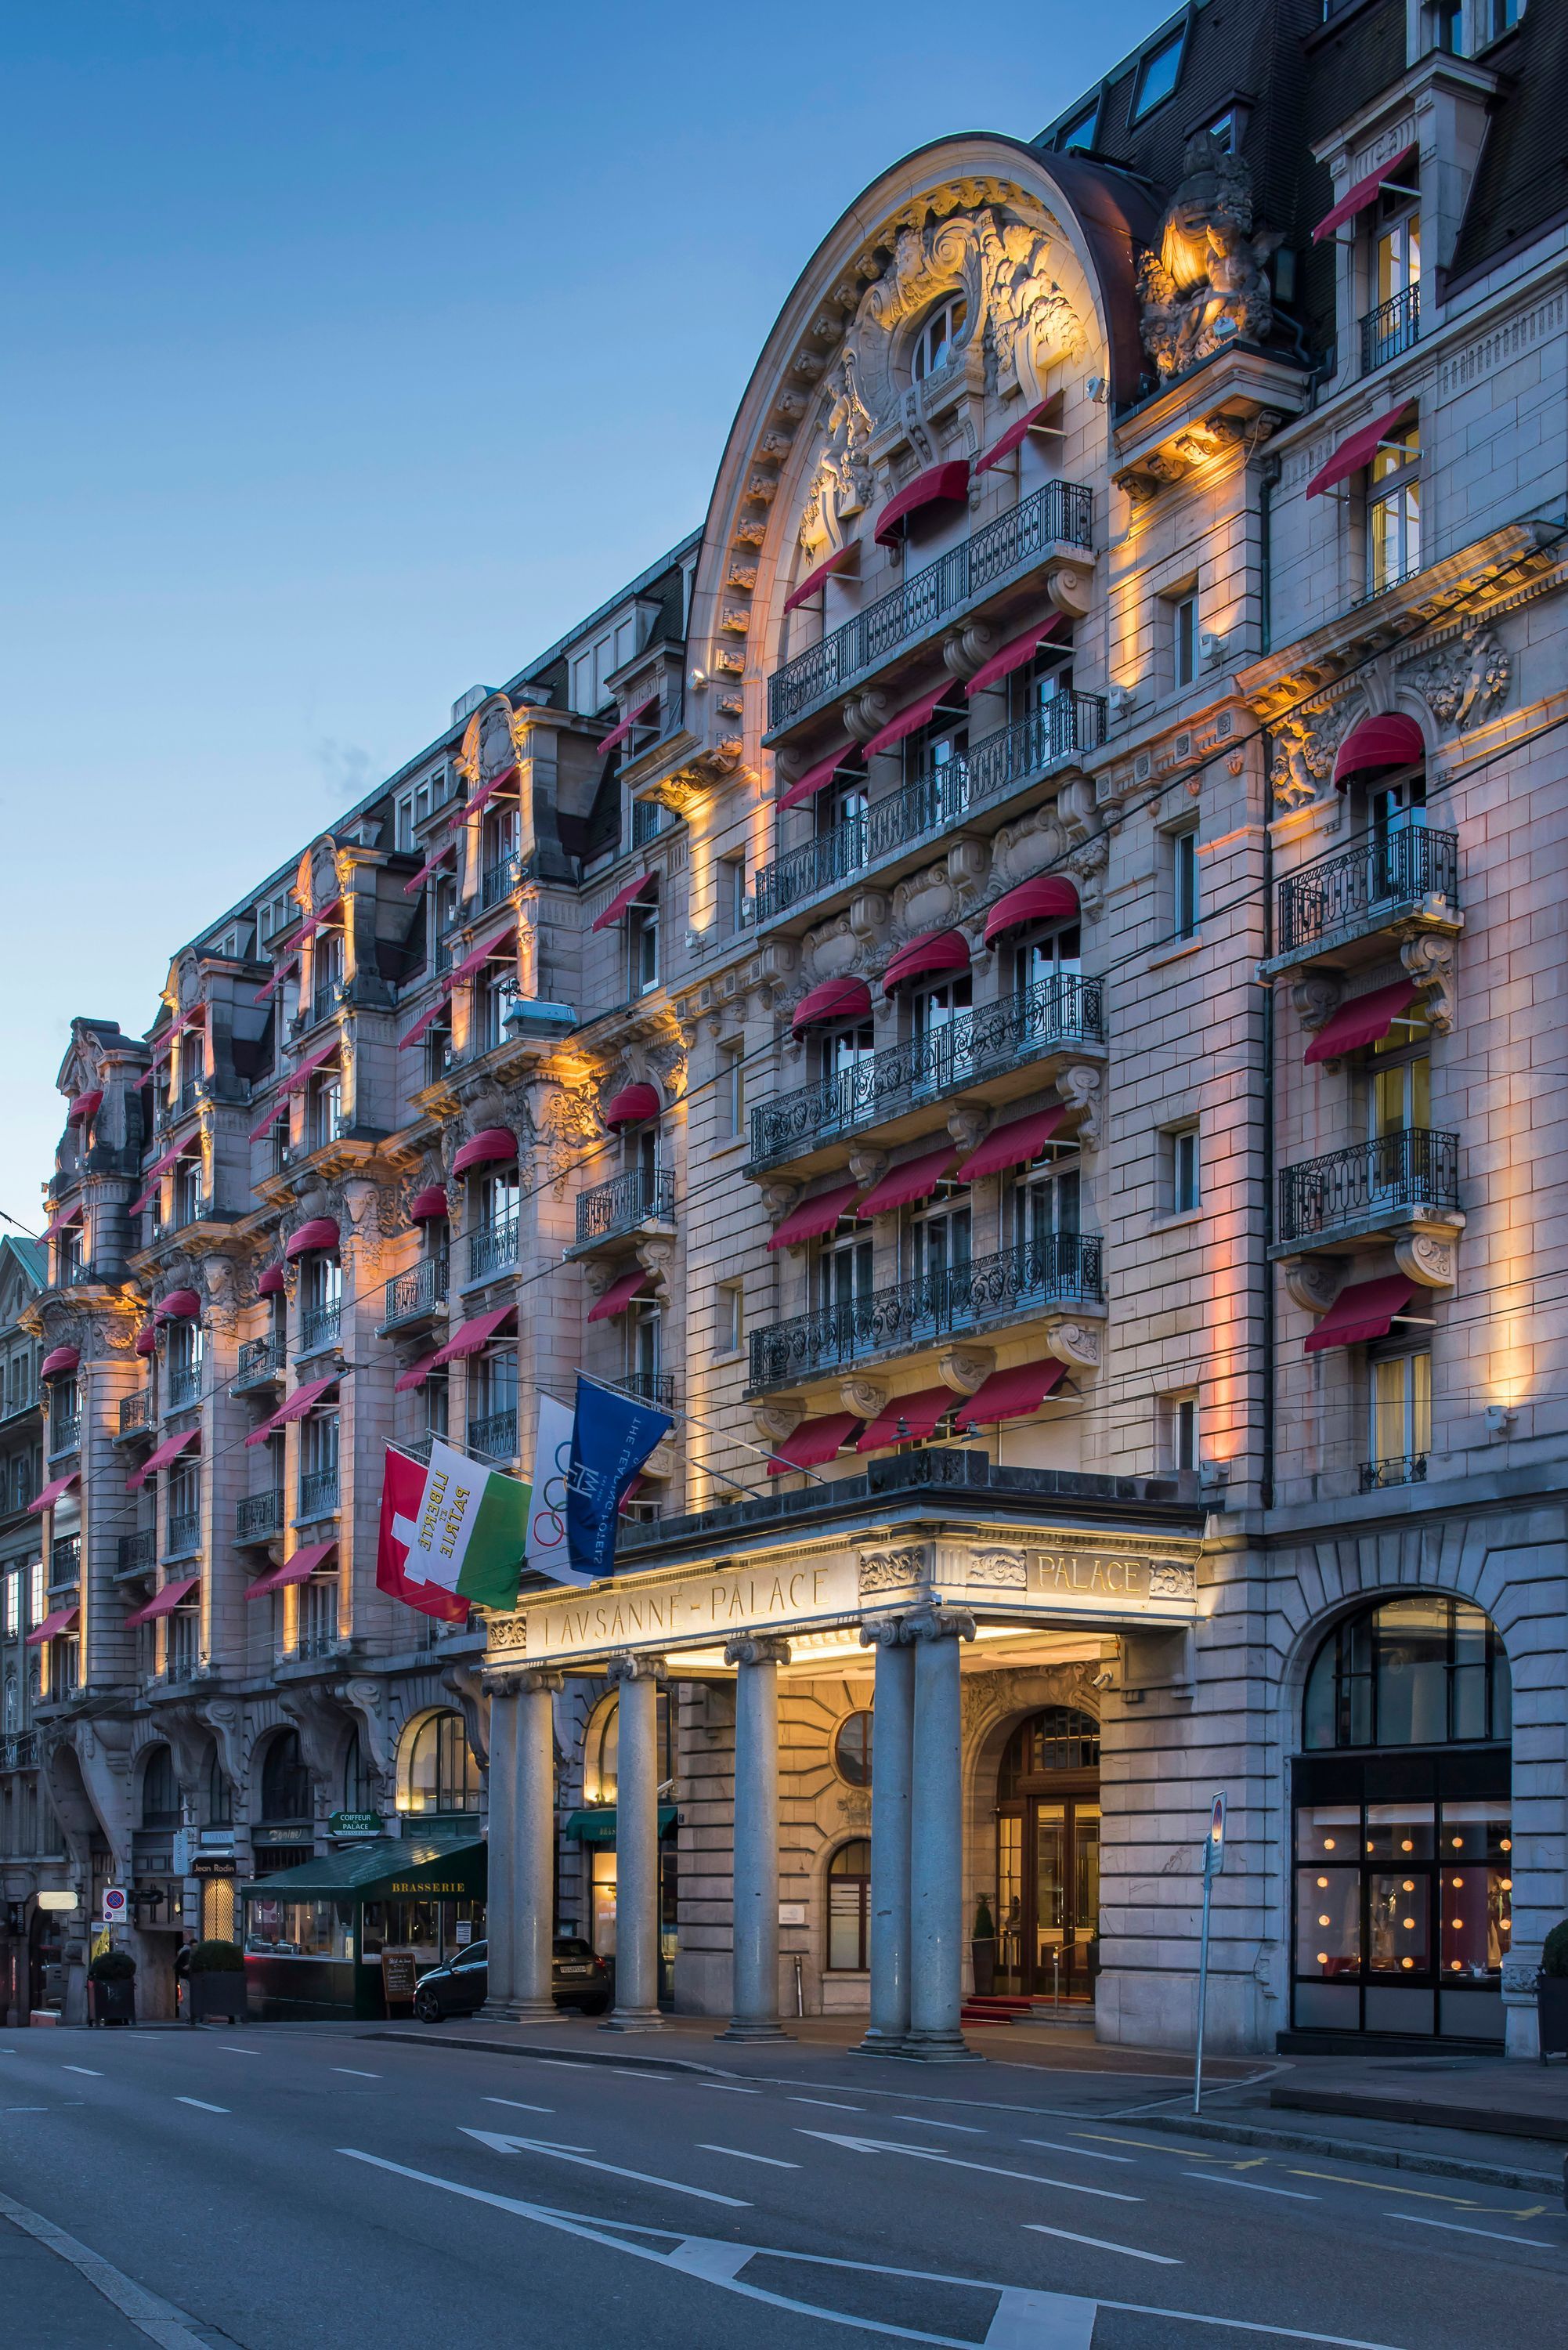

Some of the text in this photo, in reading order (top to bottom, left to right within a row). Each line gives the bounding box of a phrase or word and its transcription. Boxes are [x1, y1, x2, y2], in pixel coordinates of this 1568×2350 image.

[1038, 1556, 1141, 1592] PALACE
[712, 1568, 829, 1622] PALACE
[392, 1882, 465, 1893] BRASSERIE
